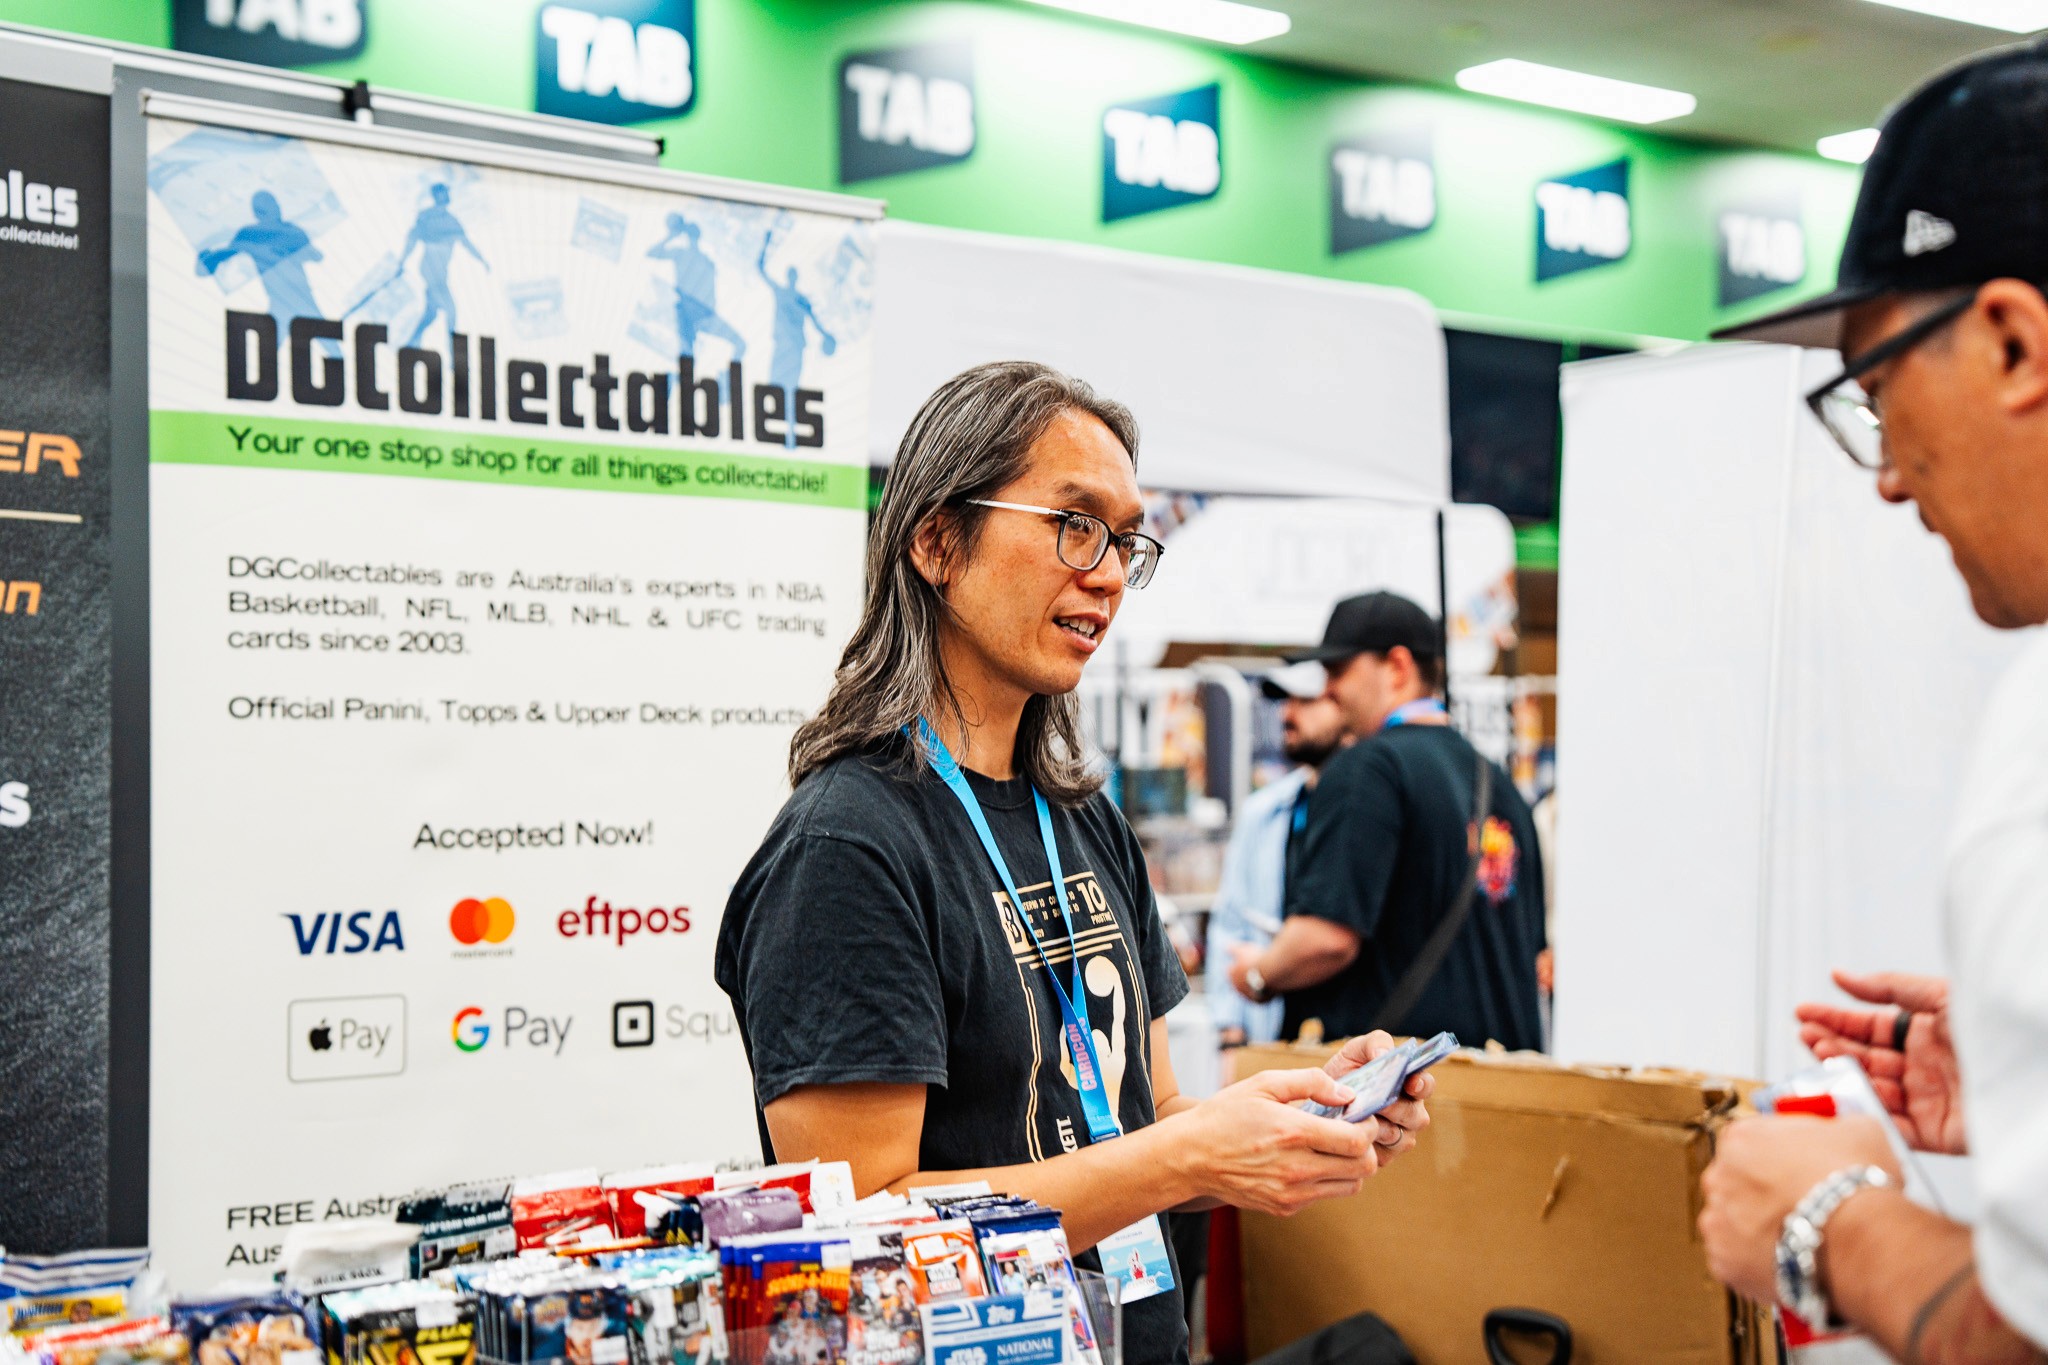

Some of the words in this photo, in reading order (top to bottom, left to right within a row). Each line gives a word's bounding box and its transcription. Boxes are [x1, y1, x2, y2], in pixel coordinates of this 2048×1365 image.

[541, 4, 693, 108] TAB
[845, 62, 976, 156] TAB
[1103, 107, 1222, 196] TAB
[1332, 148, 1436, 230] TAB
[1535, 181, 1631, 260] TAB
[1720, 212, 1806, 284] TAB
[226, 309, 824, 448] DGCollectables
[227, 425, 304, 455] Your
[314, 437, 370, 459] one
[380, 440, 444, 469] stop
[452, 444, 518, 475] shop
[526, 448, 563, 474] for
[571, 454, 598, 476] all
[608, 455, 688, 486] things
[695, 463, 828, 494] collectable!
[228, 555, 442, 588] DGCollectables
[456, 570, 495, 589] are
[508, 569, 633, 595] Australia's
[646, 578, 736, 600] experts
[748, 583, 766, 600] in
[776, 581, 826, 603] NBA
[228, 590, 387, 621] Basketball,
[405, 598, 469, 623] NFL,
[487, 601, 553, 627] MLB,
[571, 605, 630, 627] NHL
[647, 607, 669, 628] &
[686, 609, 743, 631] UFC
[757, 612, 826, 638] trading
[227, 629, 310, 650] cards
[319, 629, 390, 652] since
[398, 630, 471, 655] 2003.
[228, 695, 334, 720] Official
[344, 697, 431, 724] Panini,
[439, 700, 518, 726] Topps
[525, 702, 547, 723] &
[554, 702, 631, 728] Upper
[639, 703, 701, 725] Deck
[413, 821, 564, 853] Accepted
[576, 820, 654, 846] Now!
[557, 895, 691, 947] eftpos
[1076, 879, 1107, 914] 10
[280, 910, 405, 956] VISA
[340, 1017, 391, 1058] Pay
[504, 1005, 573, 1057] Pay
[665, 1003, 733, 1044] Squ
[1067, 1023, 1097, 1092] CARDCON
[227, 1200, 315, 1231] FREE
[997, 1337, 1055, 1357] NATIONAL
